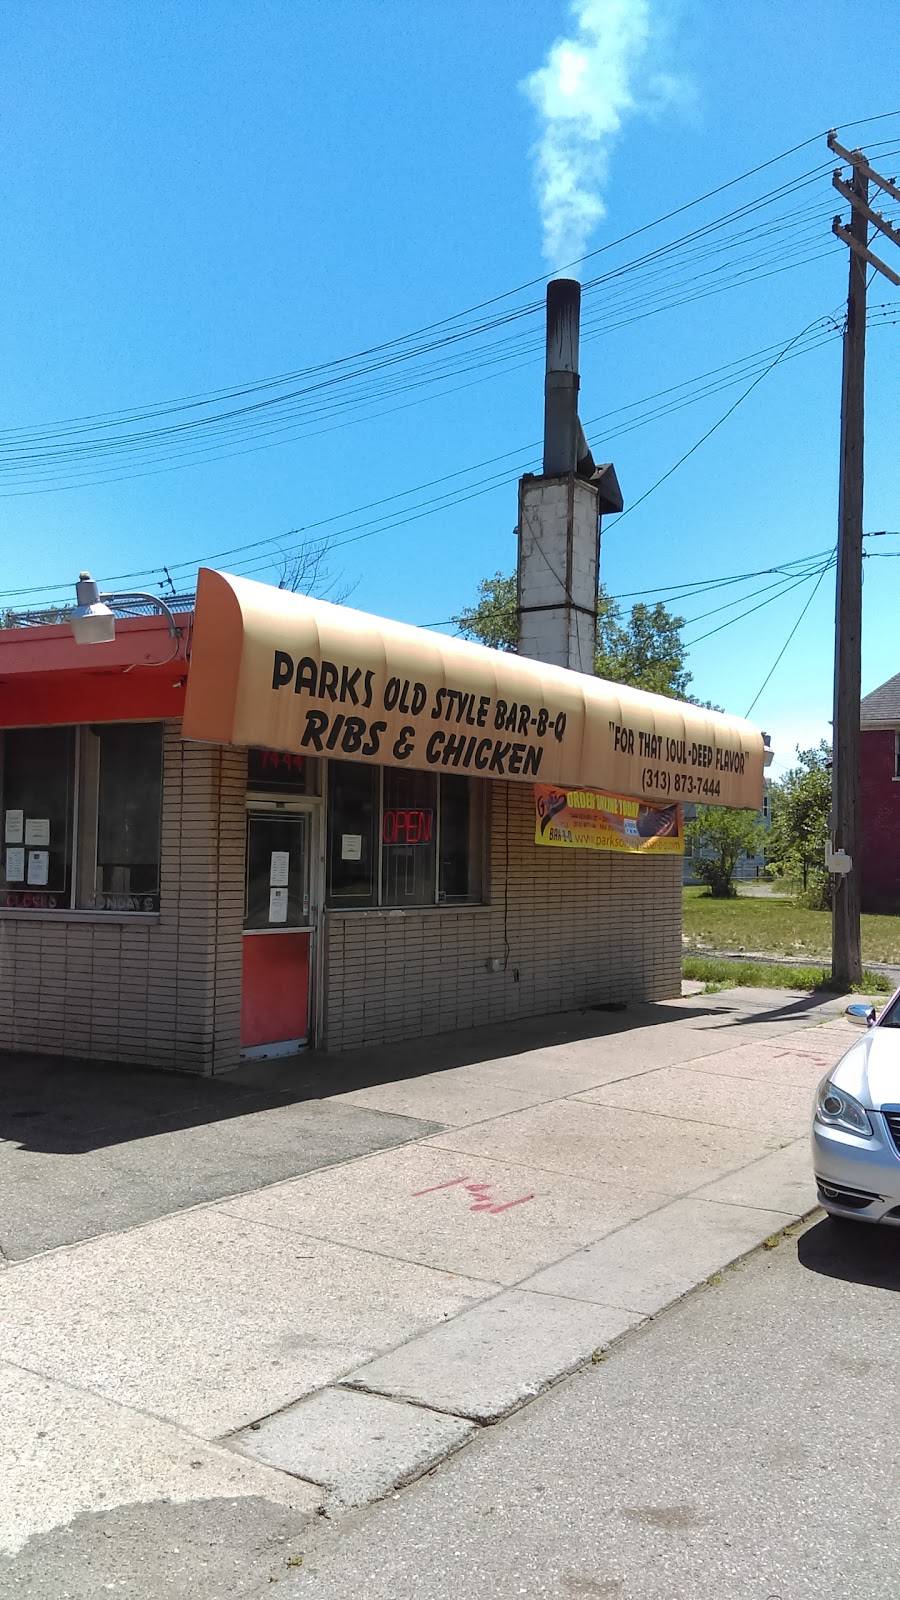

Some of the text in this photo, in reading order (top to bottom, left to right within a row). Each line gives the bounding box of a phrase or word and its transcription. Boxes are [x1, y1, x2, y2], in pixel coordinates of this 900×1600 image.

[272, 650, 567, 742] PARKS OLD STYLE BAR-B-Q
[300, 709, 544, 776] RIBS & CHICKEN
[638, 731, 663, 760] THAT
[666, 737, 713, 768] SOUL-DEEP
[642, 768, 721, 797] (313) 873-7444
[383, 811, 433, 844] OPEN
